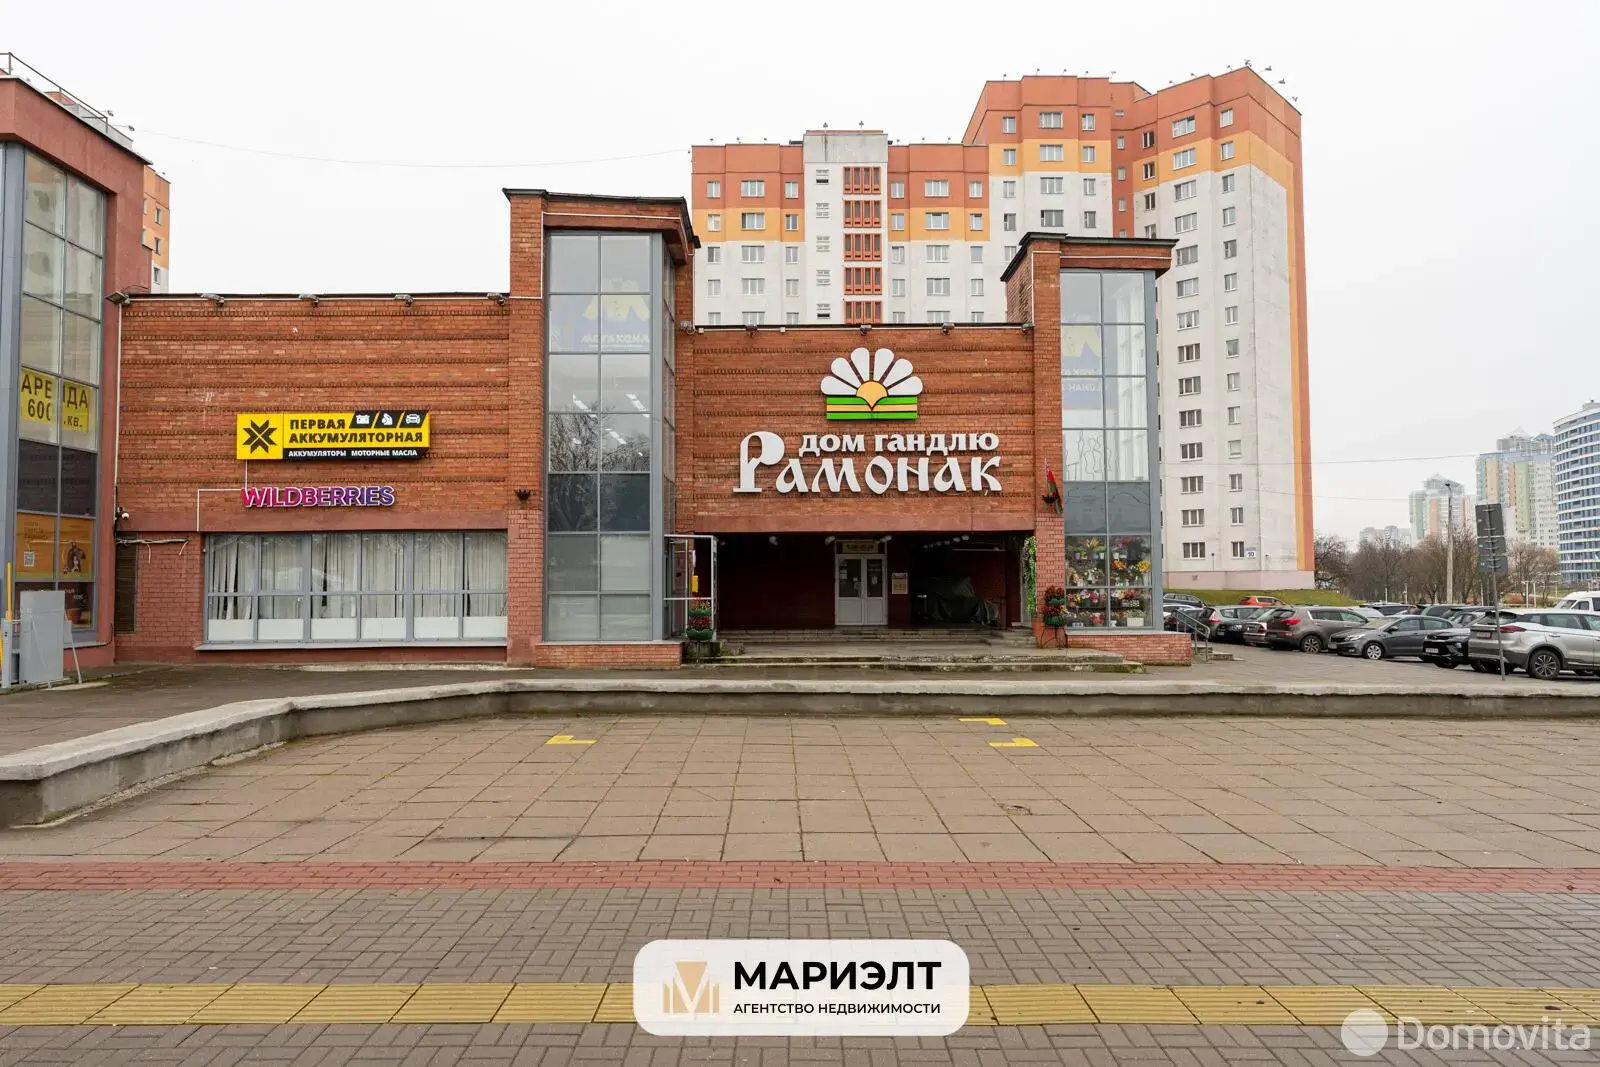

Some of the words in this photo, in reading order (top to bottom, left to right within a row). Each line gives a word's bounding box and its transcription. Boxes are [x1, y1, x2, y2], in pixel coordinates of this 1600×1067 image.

[21, 374, 88, 409] АРЕДА
[290, 419, 346, 430] ПЕРВАЯ
[288, 432, 423, 444] АККУМУЛЯТОРНАЯ
[798, 434, 865, 457] дом
[874, 432, 1000, 457] гандлю
[351, 449, 390, 457] МОТОРНЫЕ
[240, 486, 395, 508] WILDBERRIES
